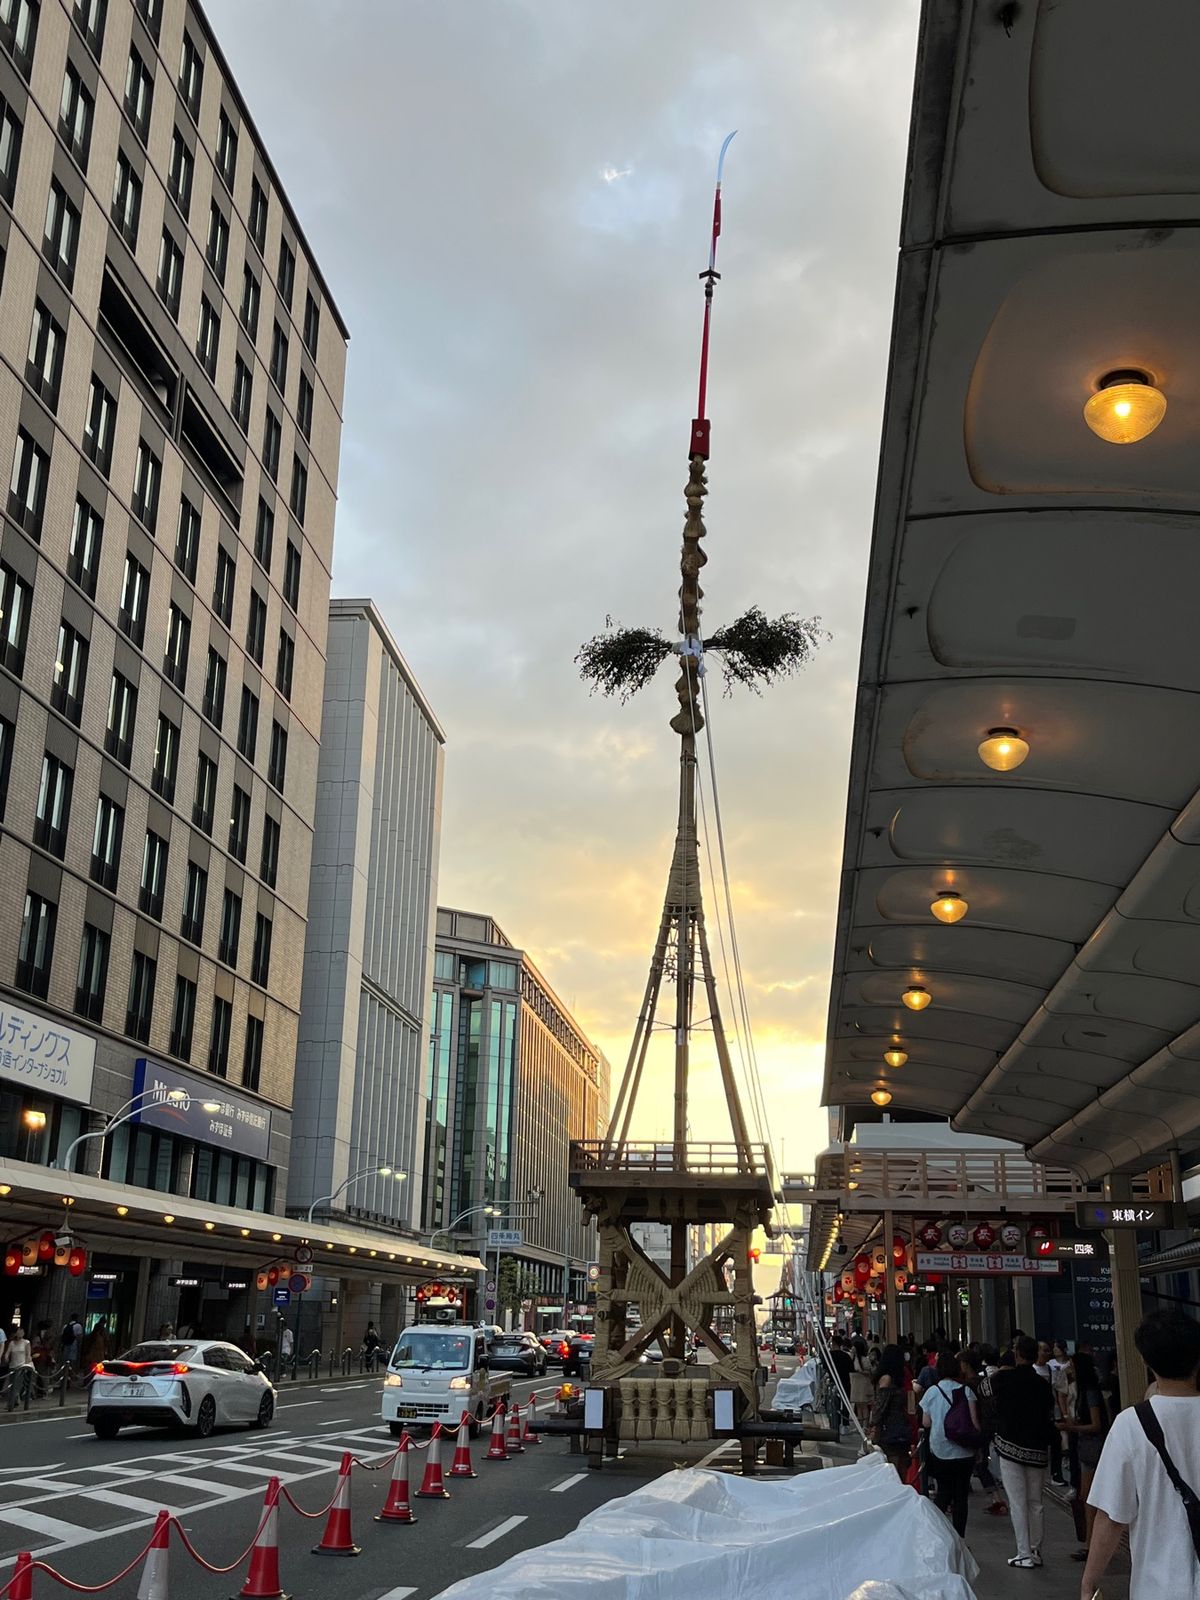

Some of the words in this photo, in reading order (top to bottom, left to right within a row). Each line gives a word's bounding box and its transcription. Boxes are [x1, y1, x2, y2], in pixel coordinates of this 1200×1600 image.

[1111, 1208, 1156, 1222] 東横イン
[1074, 1243, 1095, 1255] 四条
